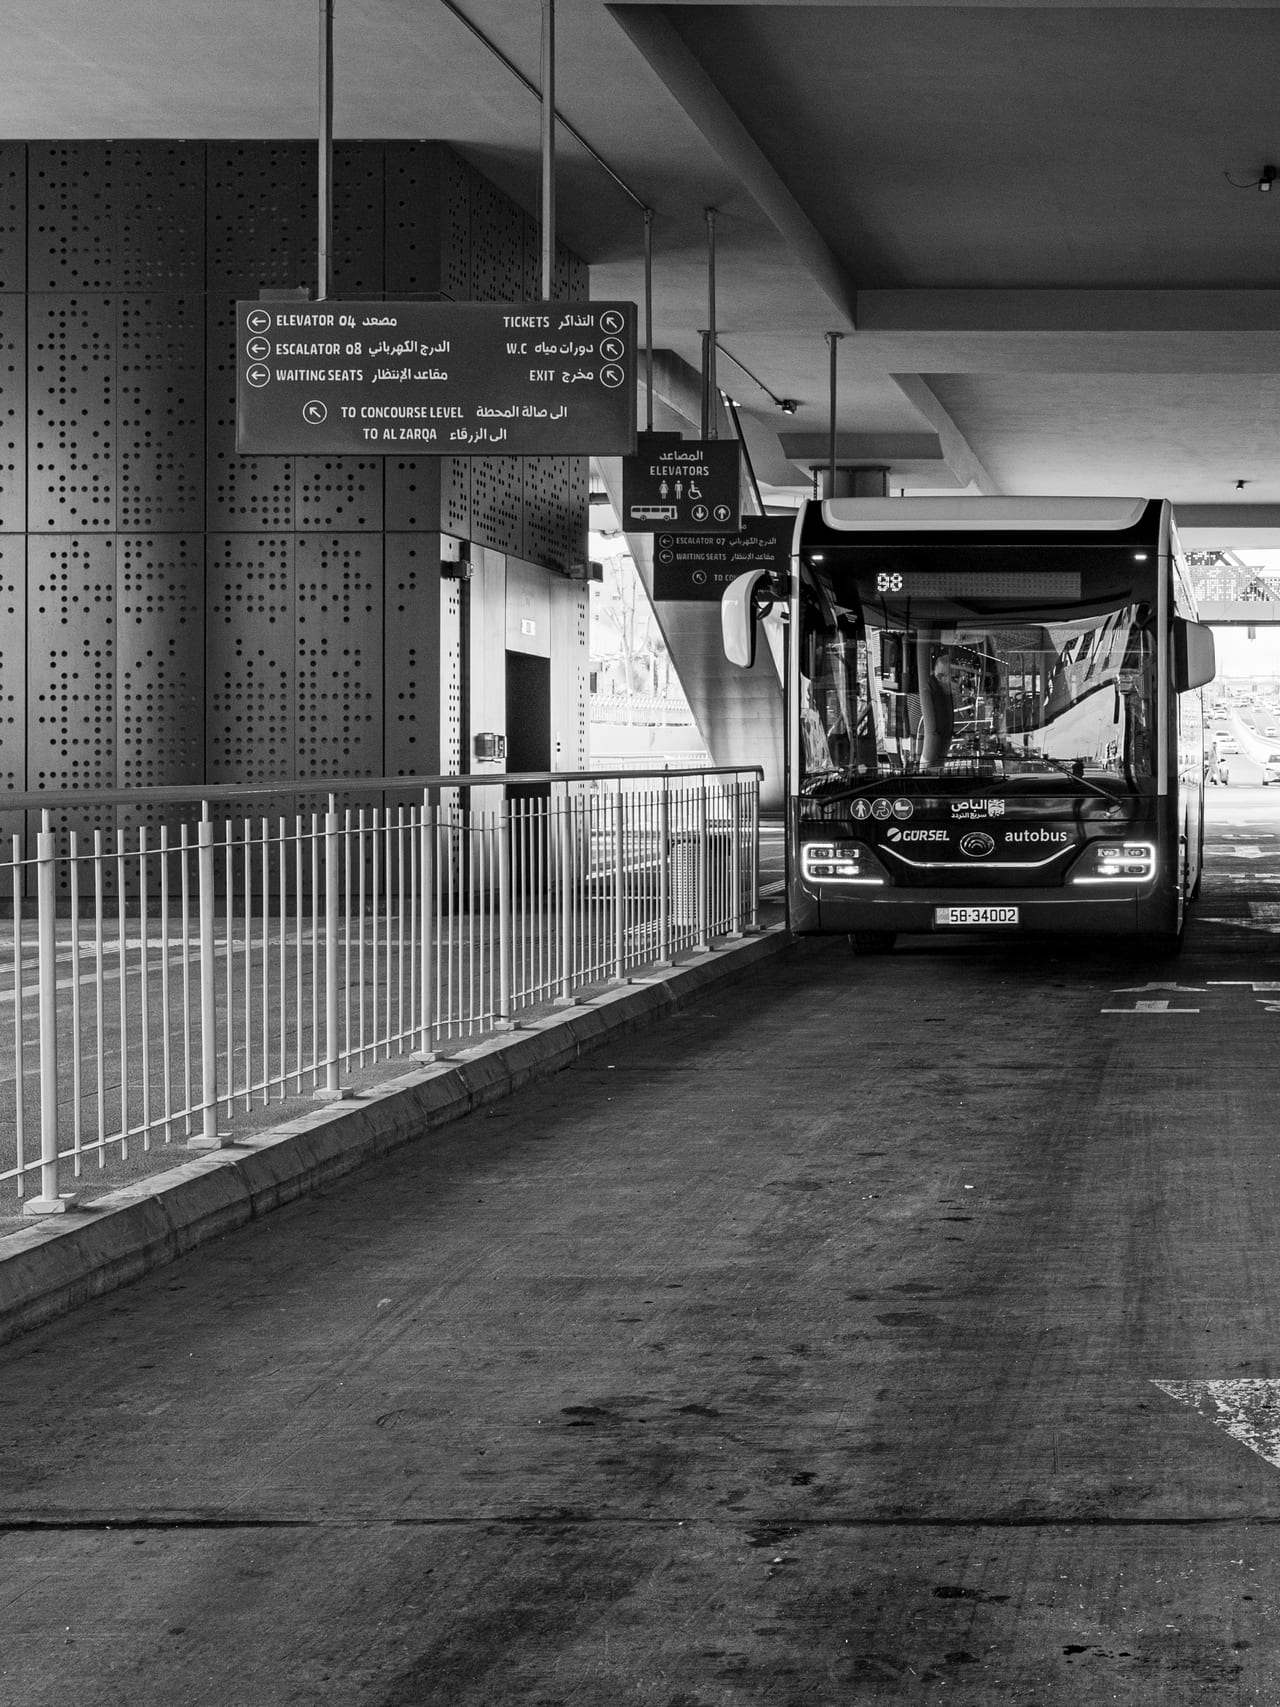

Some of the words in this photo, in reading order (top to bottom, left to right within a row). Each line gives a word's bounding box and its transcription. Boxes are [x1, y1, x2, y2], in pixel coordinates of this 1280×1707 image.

[276, 314, 335, 327] ELEVATOR
[338, 315, 357, 329] 04
[361, 316, 398, 327] مصعد
[502, 316, 550, 328] TICKETS
[557, 314, 594, 331] التذاكر
[275, 343, 341, 355] ESCALATOR
[345, 341, 362, 355] 08
[368, 340, 418, 358] الكهربائي
[419, 339, 450, 357] الدرج
[506, 342, 528, 355] W.C
[534, 341, 558, 356] مياه
[559, 341, 594, 357] دورات
[275, 369, 326, 382] WAITING
[327, 369, 364, 382] SEATS
[413, 368, 448, 381] مقاعد
[529, 369, 556, 382] EXIT
[561, 368, 594, 384] مخرج
[340, 406, 357, 418] TO
[360, 406, 428, 419] CONCOURSE
[429, 406, 464, 419] LEVEL
[476, 404, 520, 418] المحطة
[521, 404, 548, 418] صالة
[549, 405, 568, 420] الى
[362, 427, 379, 440] TO
[382, 428, 397, 440] AL
[399, 428, 437, 443] ZARQA
[449, 427, 487, 444] الزرقاء
[489, 427, 507, 442] الى
[659, 449, 704, 462] المصاعد
[649, 465, 710, 476] ELEVATORS
[675, 536, 714, 545] ESCALATOR
[715, 537, 726, 546] 07
[675, 552, 706, 561] WAITING
[706, 552, 727, 561] SEATS
[713, 573, 724, 582] TO
[876, 572, 903, 592] 98
[951, 799, 988, 813] الباص
[902, 829, 950, 842] GÜRSEL
[1004, 828, 1068, 842] autobus
